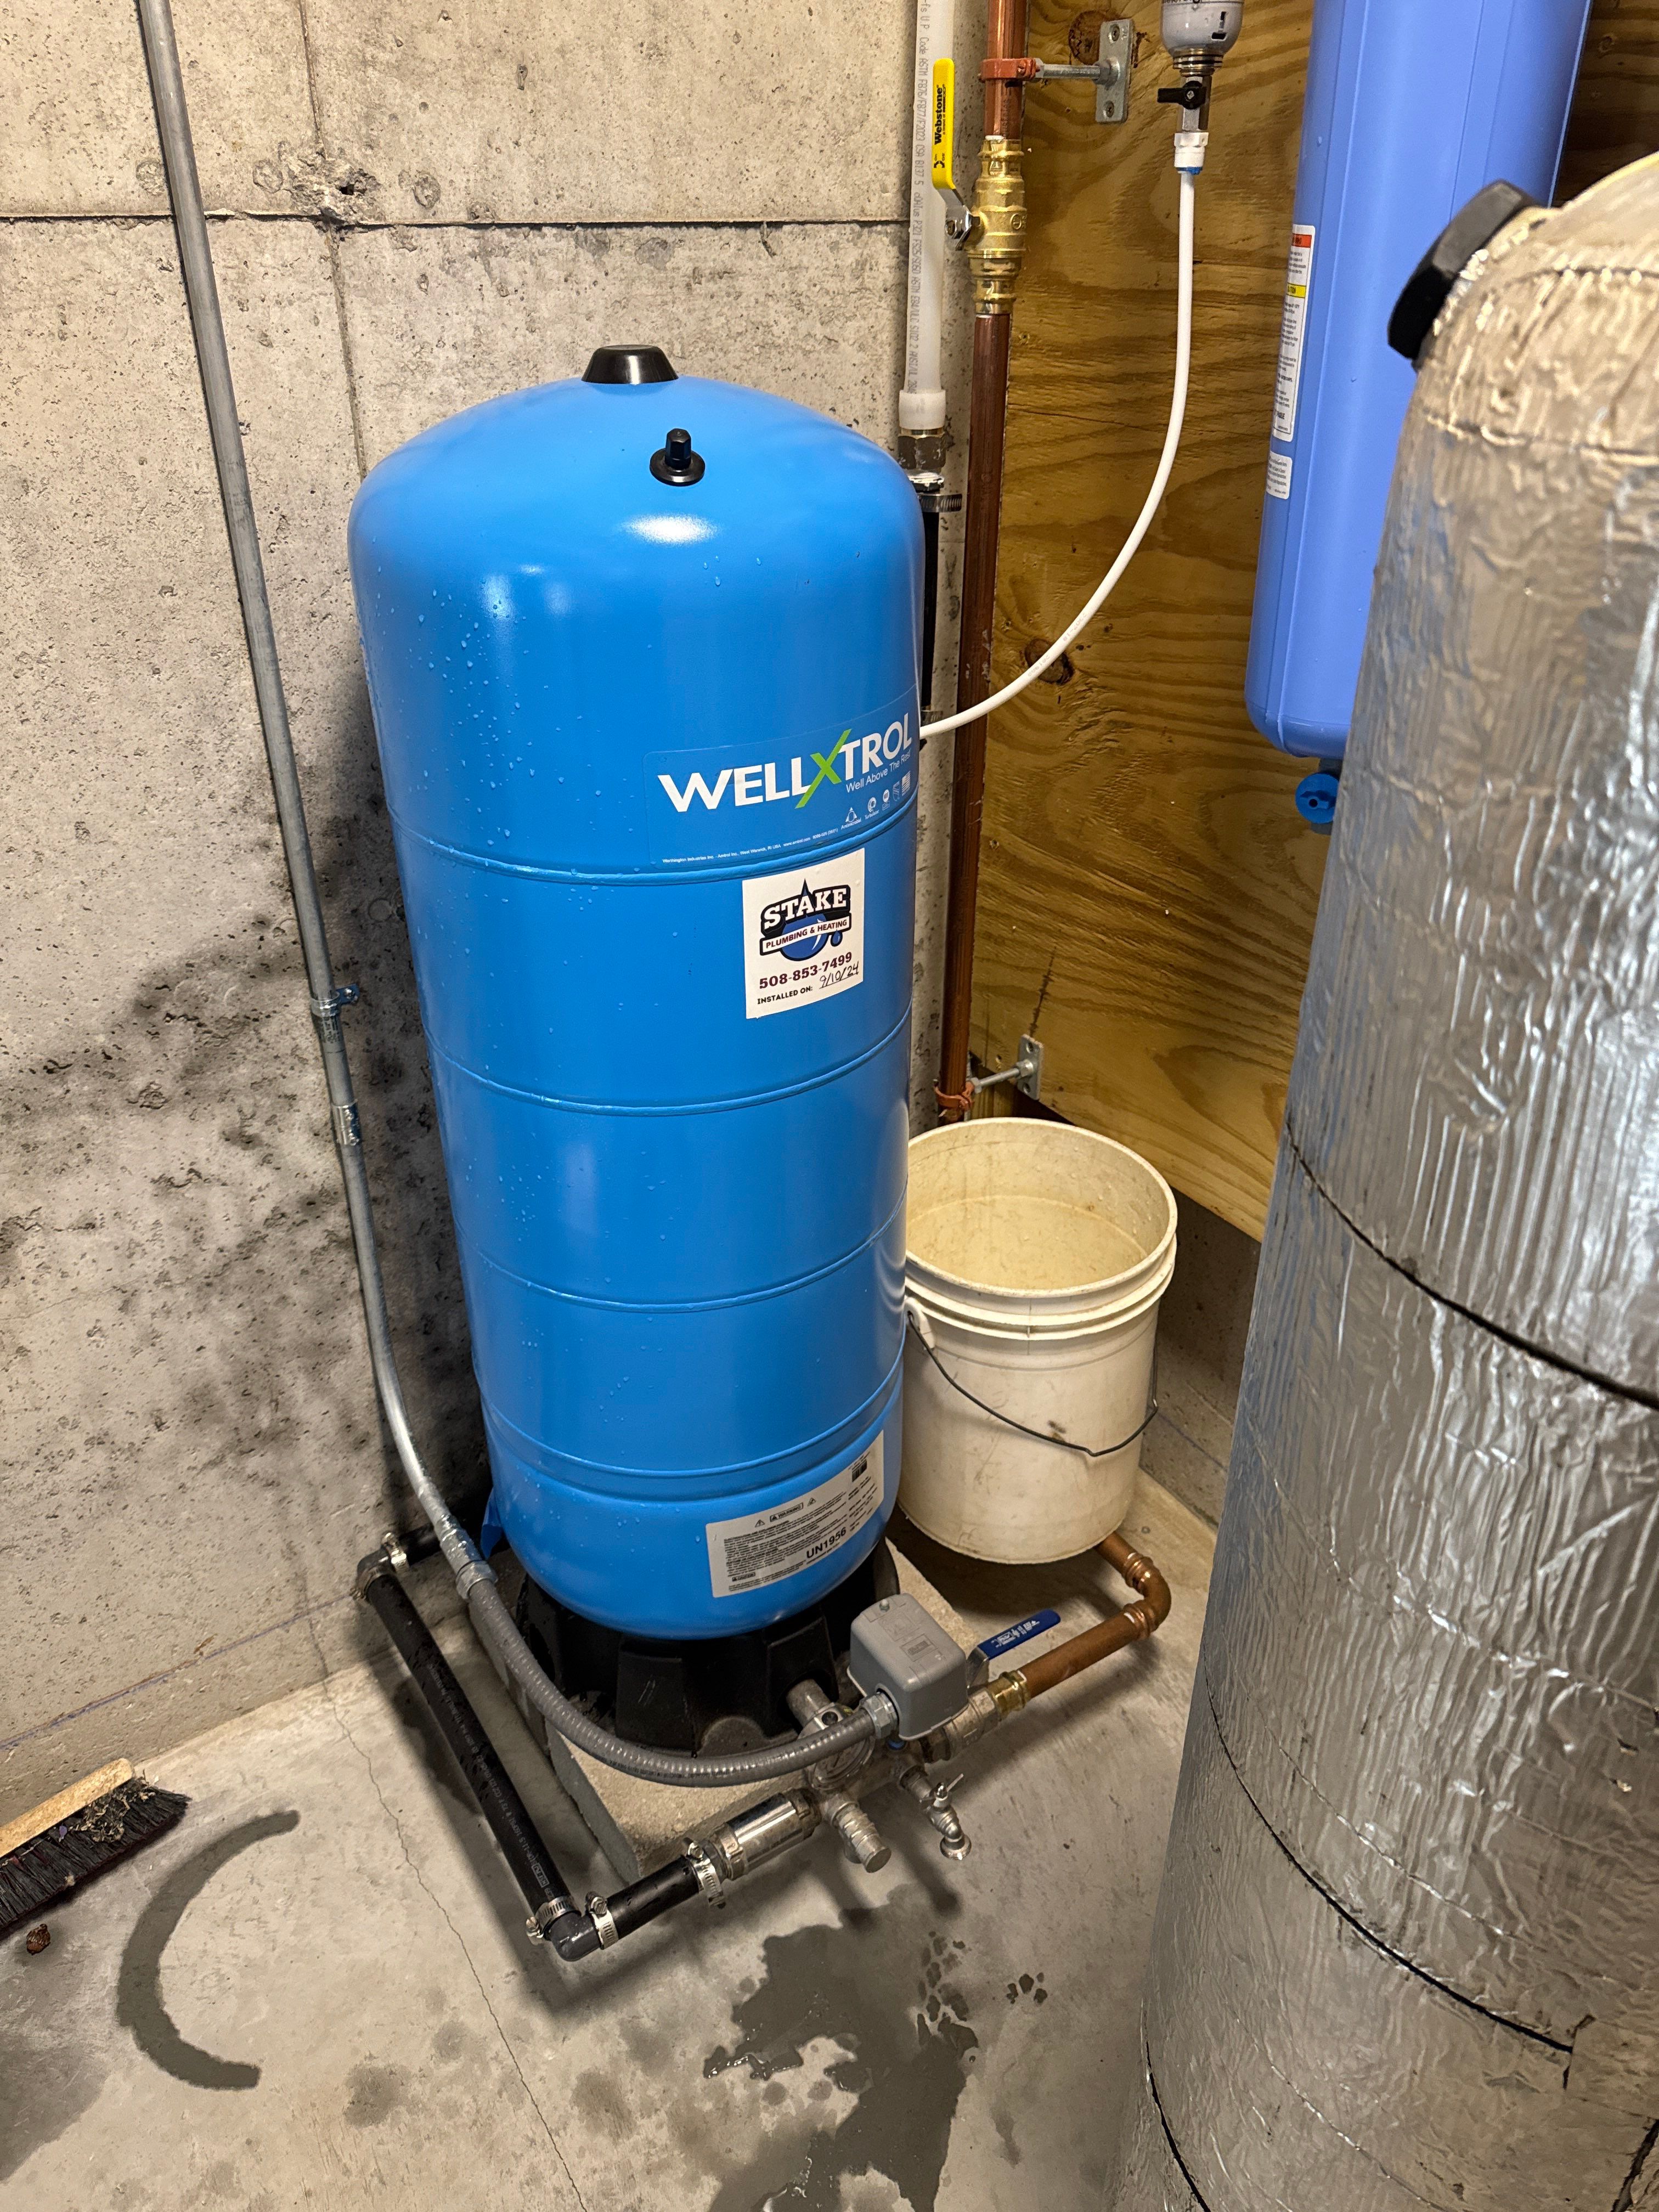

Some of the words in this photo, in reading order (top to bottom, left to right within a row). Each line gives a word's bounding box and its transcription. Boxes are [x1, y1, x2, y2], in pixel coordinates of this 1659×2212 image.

[919, 37, 929, 54] Code
[918, 58, 928, 76] ASTM
[934, 87, 943, 145] Webstone
[845, 778, 864, 793] Well
[866, 769, 888, 786] Above
[889, 760, 900, 772] The
[901, 749, 911, 763] Rest
[764, 887, 848, 929] STAKE
[765, 929, 808, 949] PLUMBING
[809, 926, 816, 935] &
[817, 918, 848, 934] HEATING
[759, 951, 853, 989] 508-853-7499
[820, 961, 860, 989] 9/10/24
[757, 989, 798, 1005] INSTALLED
[800, 985, 813, 995] ON:
[806, 1527, 847, 1559] UN1956
